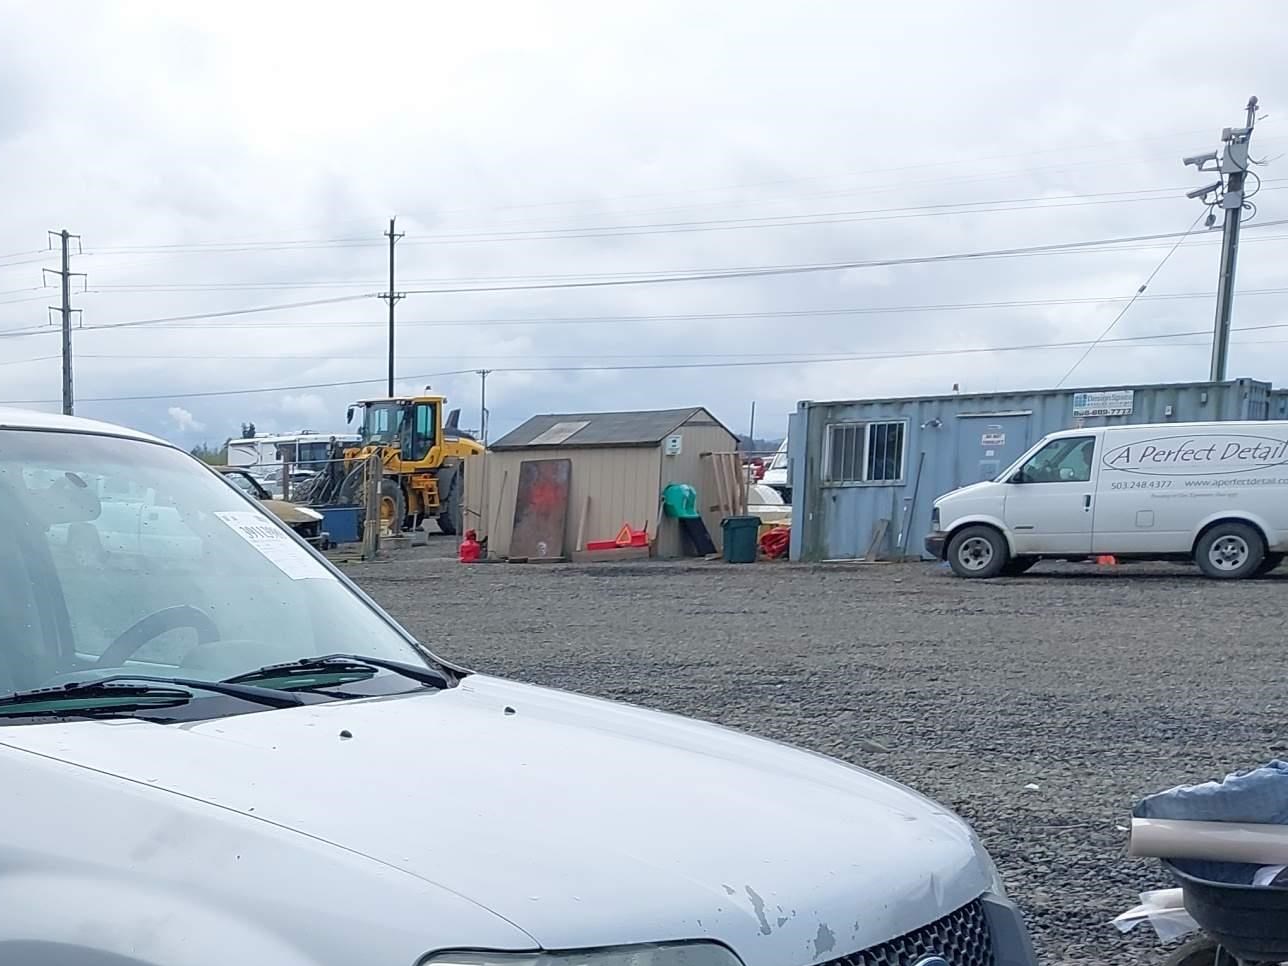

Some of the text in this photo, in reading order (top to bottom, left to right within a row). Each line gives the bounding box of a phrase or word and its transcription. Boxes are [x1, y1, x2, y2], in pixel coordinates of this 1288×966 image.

[1109, 439, 1288, 465] A Perfect Detail
[1111, 480, 1172, 490] 503.248.4377
